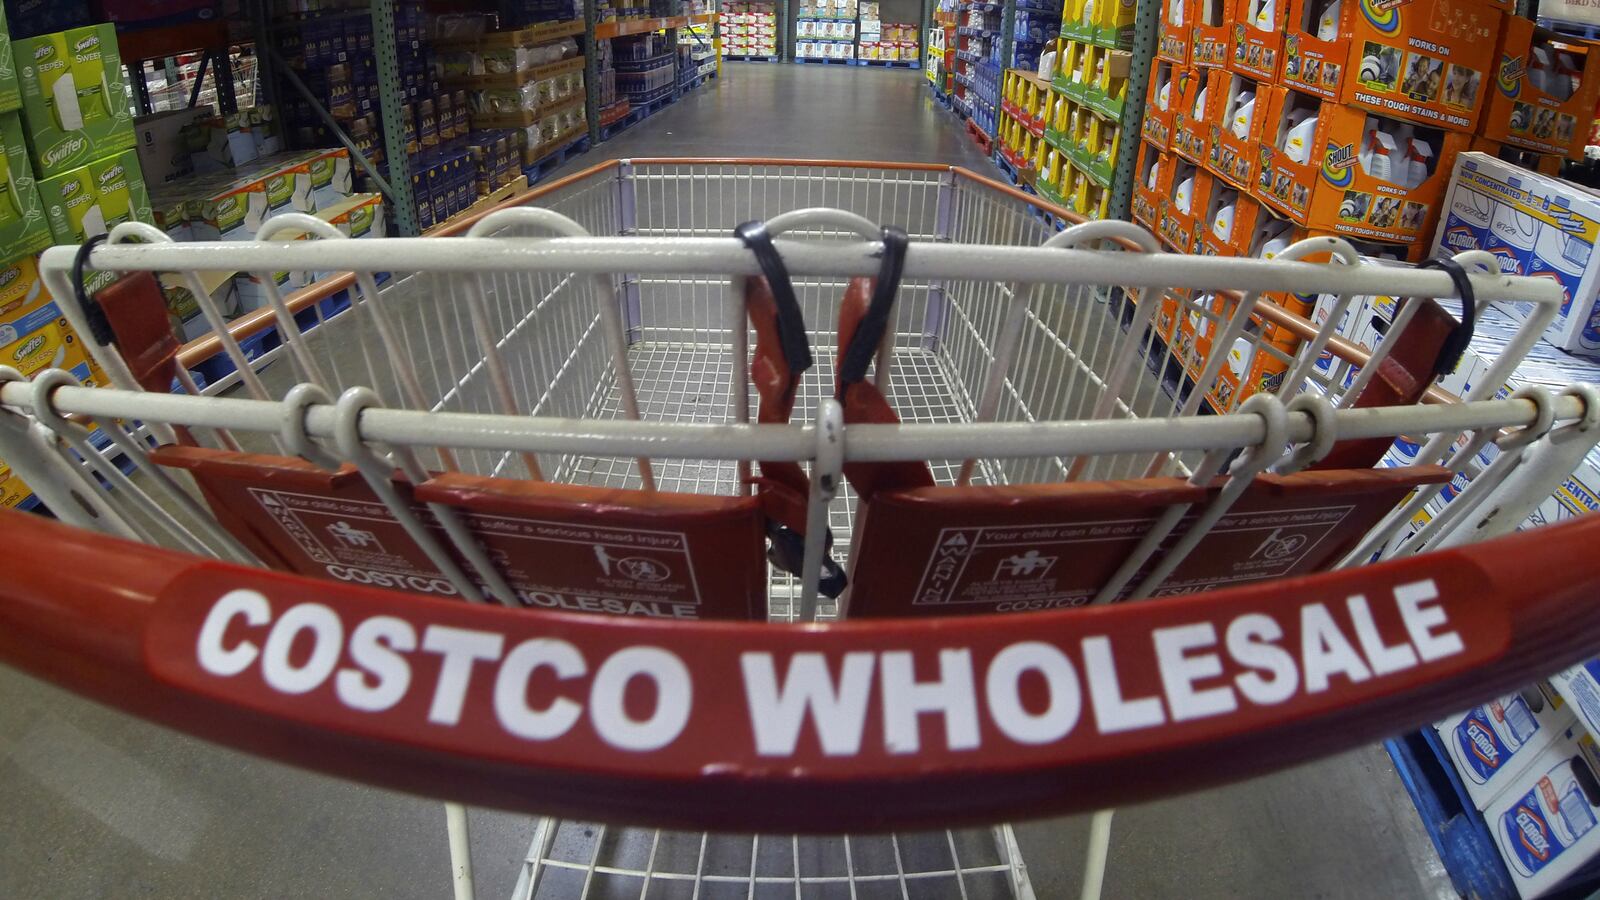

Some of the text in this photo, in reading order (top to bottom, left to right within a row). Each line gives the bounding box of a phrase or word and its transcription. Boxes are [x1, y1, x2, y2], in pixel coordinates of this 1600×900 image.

[1408, 37, 1450, 56] WORKS ON
[1354, 92, 1381, 105] THESE
[1383, 98, 1410, 112] TOUGH
[1411, 106, 1438, 119] STAINS
[46, 138, 84, 168] Swiffer
[1328, 144, 1353, 166] SHOUT
[1376, 185, 1398, 195] WORKS
[1474, 175, 1521, 200] CONCENTRATED
[1334, 224, 1353, 233] THESE
[1354, 226, 1374, 235] TOUGH
[1374, 230, 1395, 239] STAINS
[1448, 231, 1478, 248] CLOROX
[83, 270, 115, 296] wiffer
[15, 336, 44, 361] Swiffer
[1318, 511, 1345, 521] injury
[525, 525, 534, 533] a
[537, 526, 591, 538] serious
[594, 530, 633, 542] head
[636, 533, 680, 547] injury
[984, 531, 1017, 541] Your
[1021, 529, 1058, 539] child
[1060, 528, 1086, 537] can
[1089, 526, 1110, 536] fall
[1112, 525, 1135, 535] out
[326, 564, 457, 594] COSTCO
[921, 546, 968, 602] WARNING
[996, 596, 1088, 612] COSTCO
[198, 580, 1464, 756] COSTCO WHOLESALE
[1466, 724, 1499, 761] CLOROX
[1516, 811, 1550, 851] CLOROX
